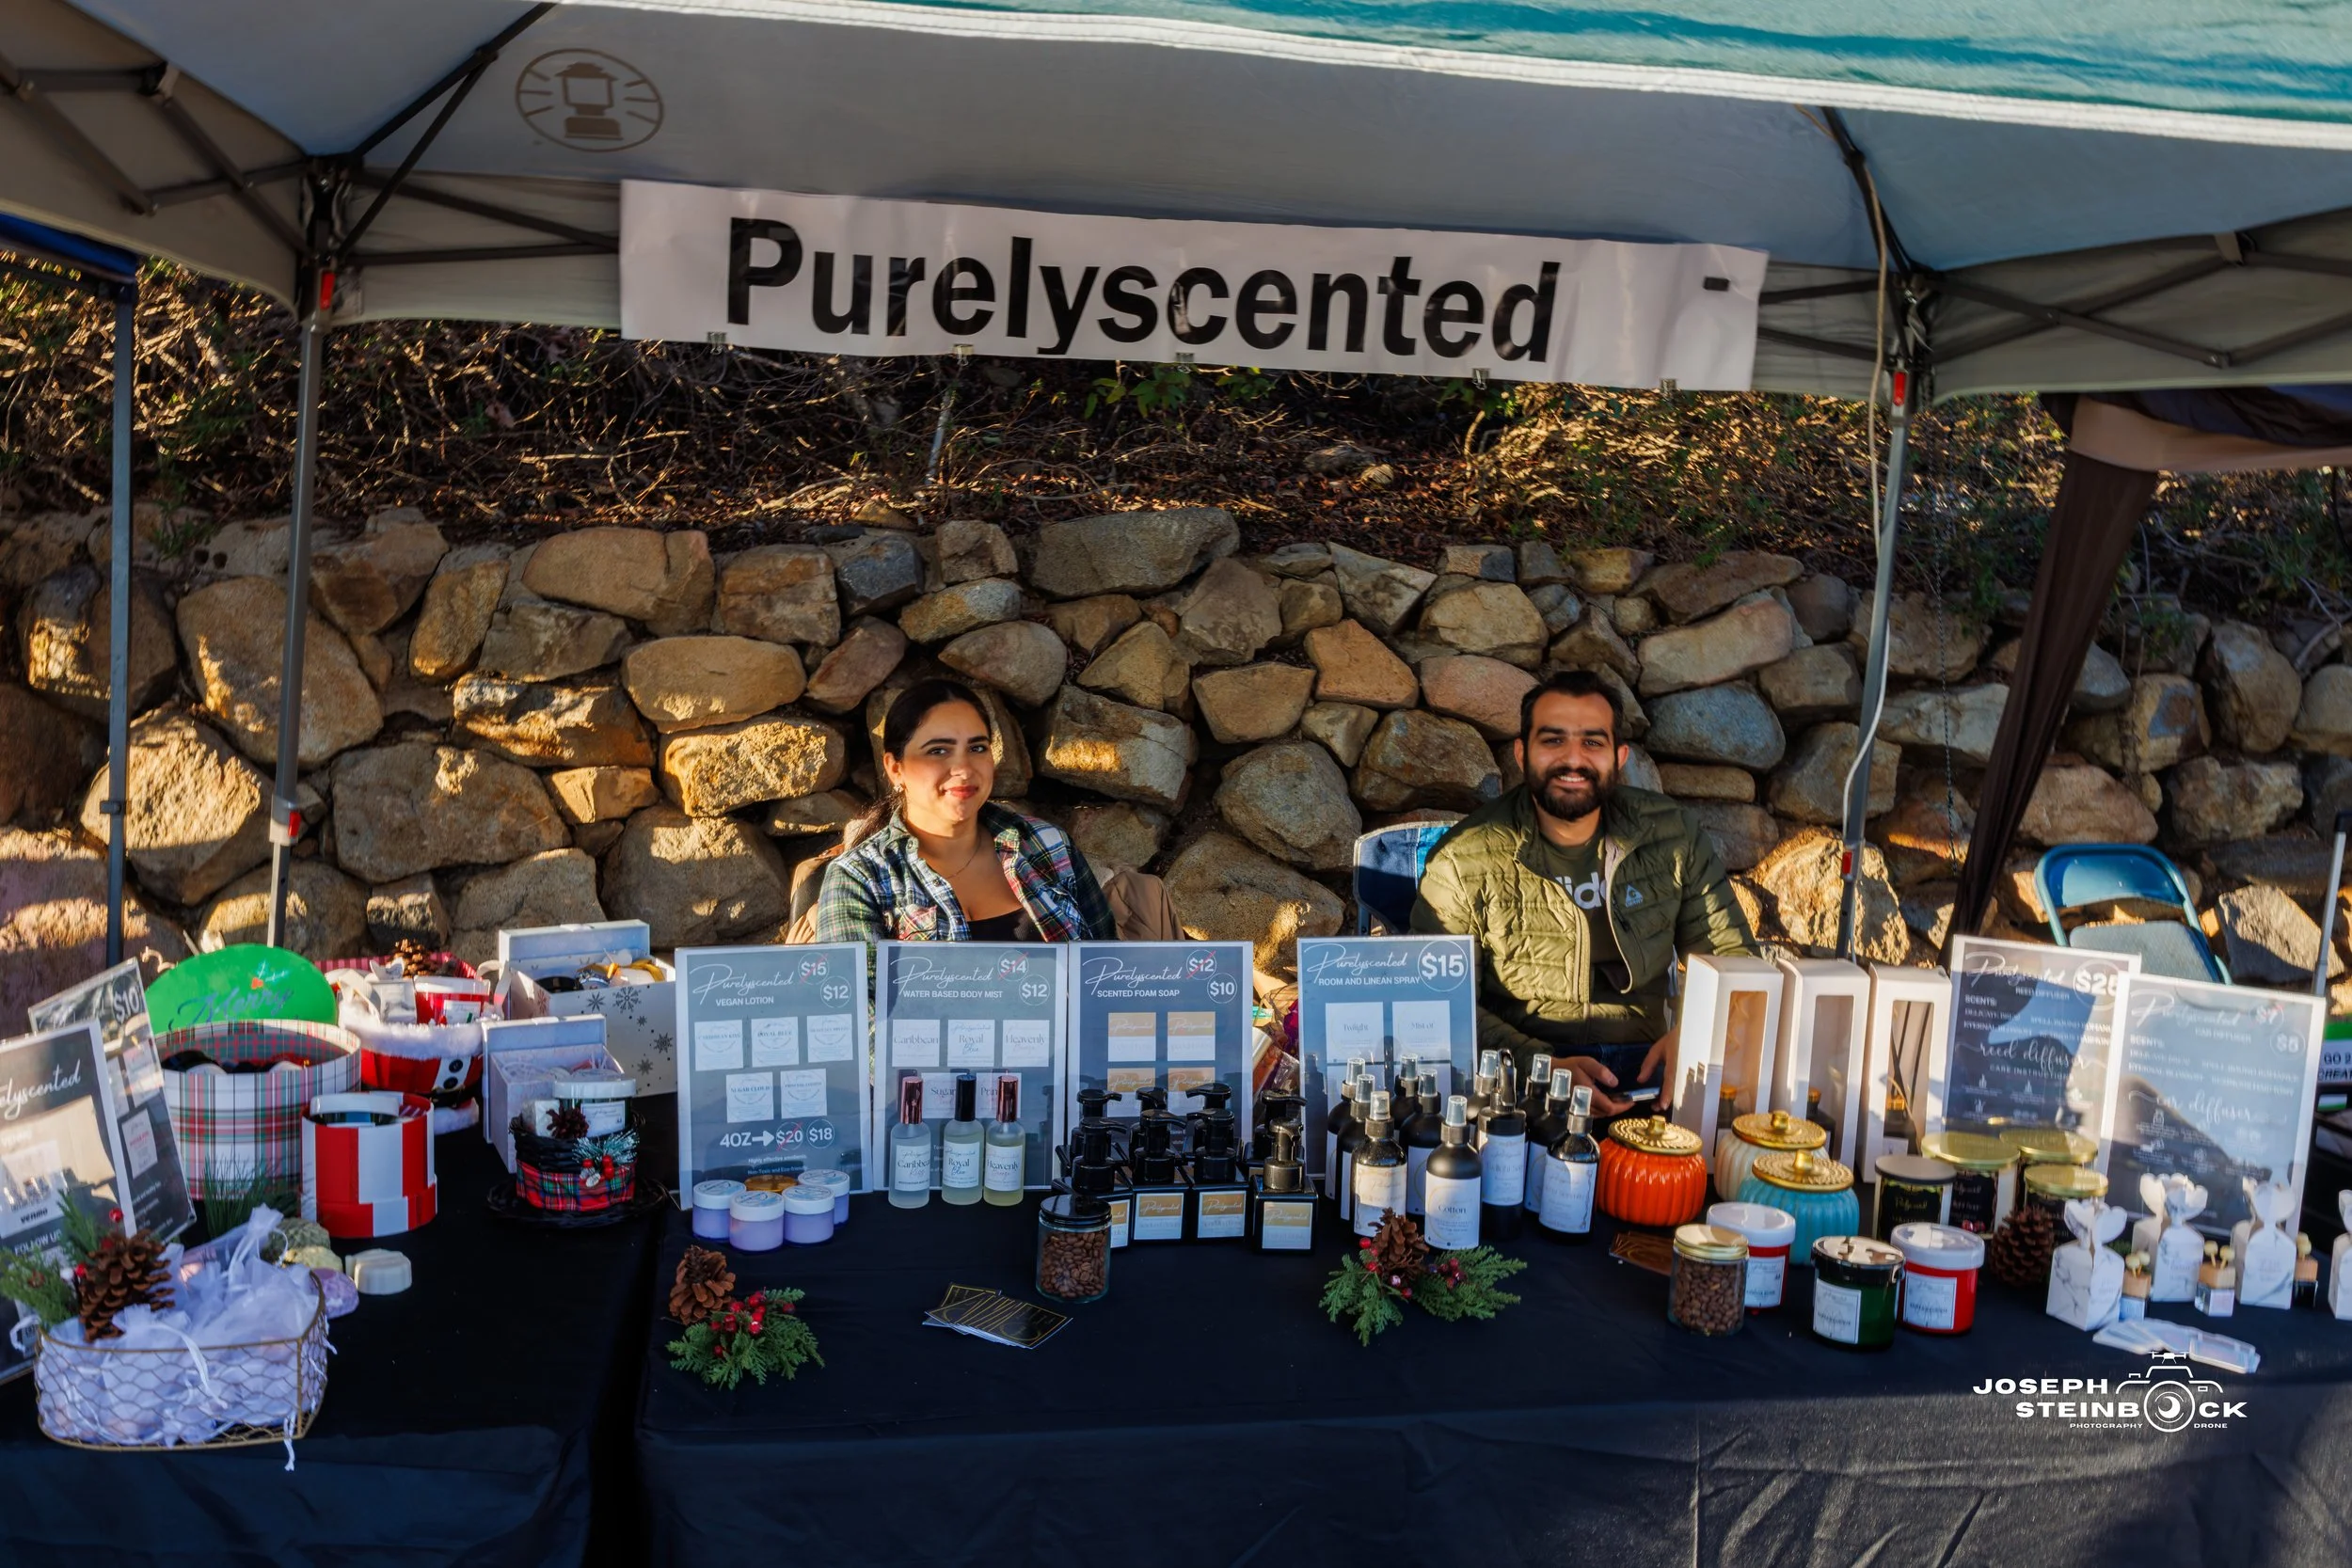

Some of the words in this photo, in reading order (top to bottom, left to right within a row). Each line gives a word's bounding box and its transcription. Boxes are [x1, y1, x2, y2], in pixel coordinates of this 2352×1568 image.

[726, 216, 1562, 365] Purelyscented
[1555, 871, 1607, 911] id
[801, 960, 827, 976] $15
[1000, 958, 1027, 974] $14
[1188, 957, 1215, 973] $12
[1304, 942, 1408, 984] Purelyscented
[1422, 952, 1465, 979] $15
[890, 956, 994, 995] Purelyscented
[1082, 956, 1184, 995] Purelyscented
[1318, 977, 1343, 986] ROOM
[1344, 977, 1362, 986] AND
[1363, 976, 1392, 985] LINEAN
[1393, 975, 1421, 985] SPRAY
[690, 963, 795, 1006] Purelyscented
[1021, 982, 1048, 999] $12
[1209, 981, 1235, 997] $10
[715, 998, 744, 1006] VEGAN
[745, 995, 774, 1005] LOTION
[822, 985, 849, 1002] $12
[902, 990, 930, 998] WATER
[931, 990, 960, 998] BASED
[960, 990, 983, 999] BODY
[984, 990, 1004, 999] MIST
[1097, 990, 1134, 998] SCENTED
[1158, 989, 1180, 997] SOAP
[113, 989, 140, 1023] $10
[894, 1033, 939, 1045] Caribbean
[959, 1034, 984, 1045] Royal
[1005, 1034, 1046, 1045] Heavenly
[720, 1132, 752, 1148] 4OZ
[776, 1130, 803, 1147] $20
[809, 1127, 833, 1143] $18
[948, 1158, 970, 1169] Royal
[1438, 1203, 1467, 1214] Cotton
